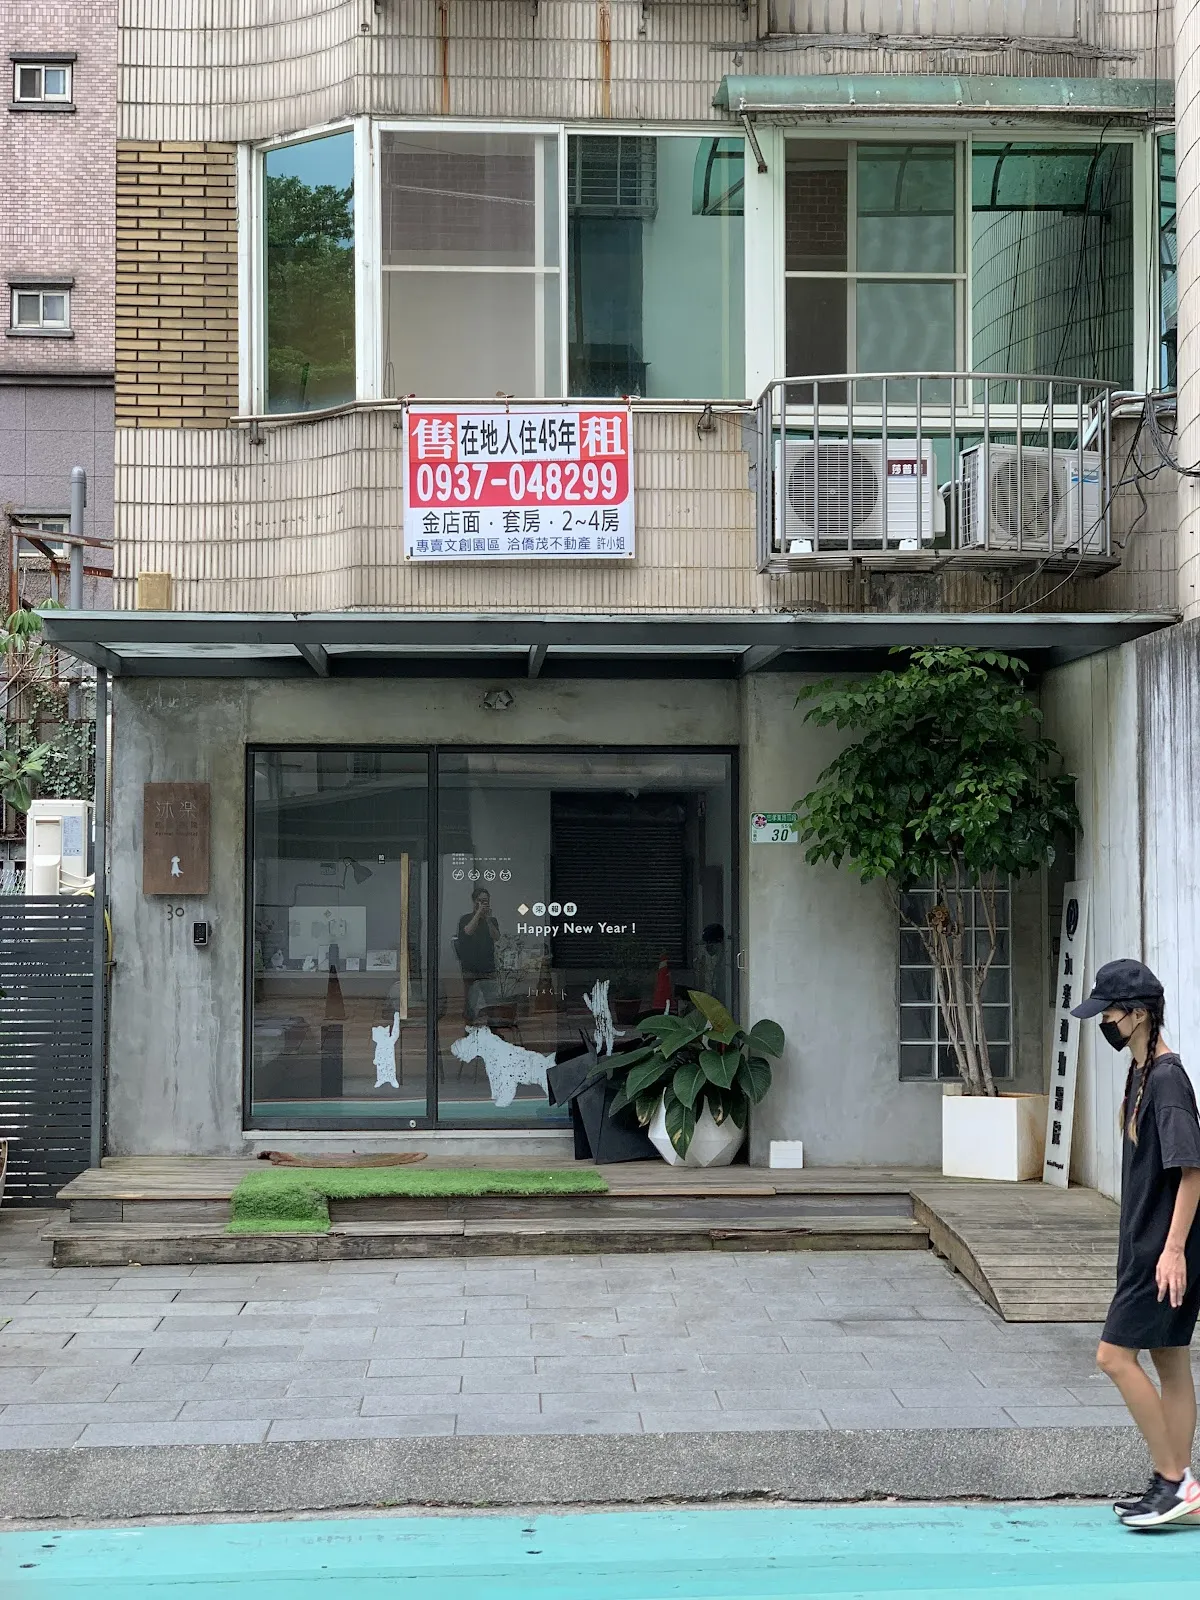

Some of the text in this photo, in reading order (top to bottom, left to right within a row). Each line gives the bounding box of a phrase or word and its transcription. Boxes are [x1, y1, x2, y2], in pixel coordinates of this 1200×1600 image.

[411, 415, 626, 459] 售 在地人住45年 租
[416, 462, 618, 502] 0937-048299
[416, 537, 626, 553] 專賣文創園區 洽僑茂不動產 許小姐
[771, 828, 789, 841] 30
[167, 904, 185, 921] 30
[517, 922, 637, 937] Happy New Year !
